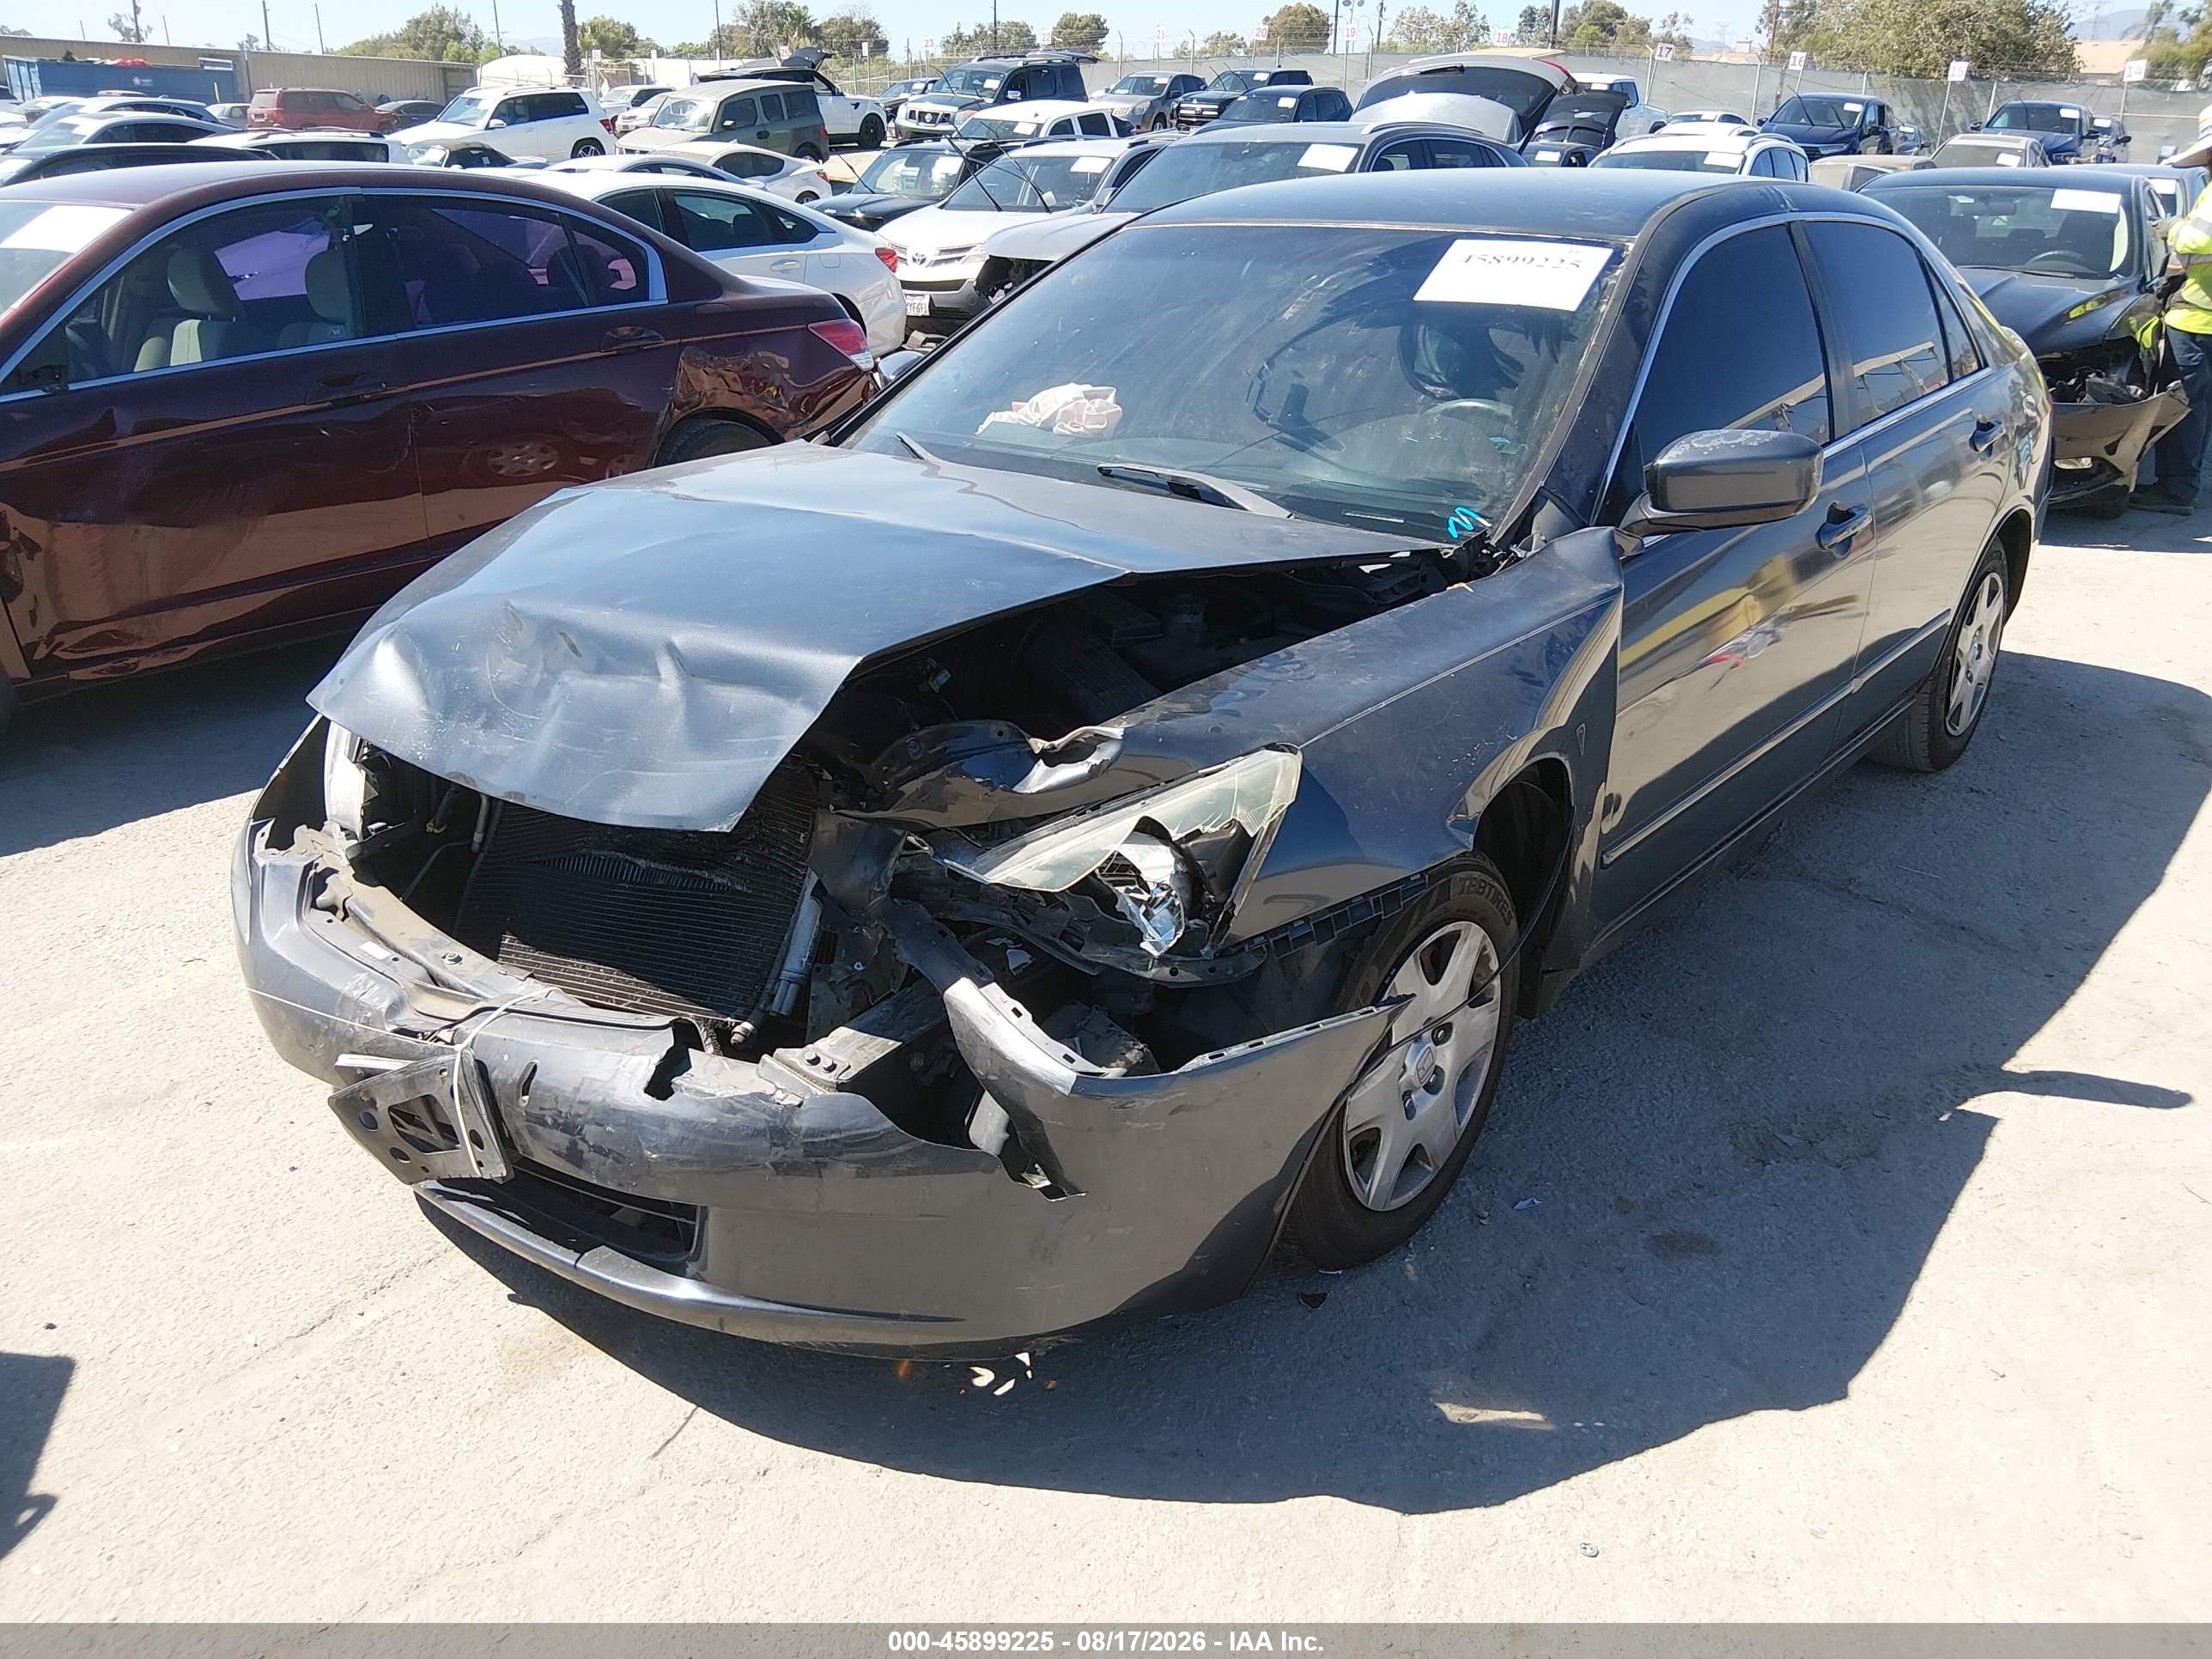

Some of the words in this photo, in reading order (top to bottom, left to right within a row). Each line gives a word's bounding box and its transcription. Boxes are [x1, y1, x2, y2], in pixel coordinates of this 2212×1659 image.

[1042, 33, 1051, 42] 22
[1156, 29, 1165, 40] 21
[1255, 27, 1267, 38] 20
[924, 39, 934, 48] 23
[1496, 33, 1509, 44] 18
[1656, 46, 1673, 58] 17
[1790, 55, 1805, 67] 16
[1950, 66, 1965, 77] 15
[2125, 64, 2142, 77] 14
[1460, 254, 1583, 270] 45899225
